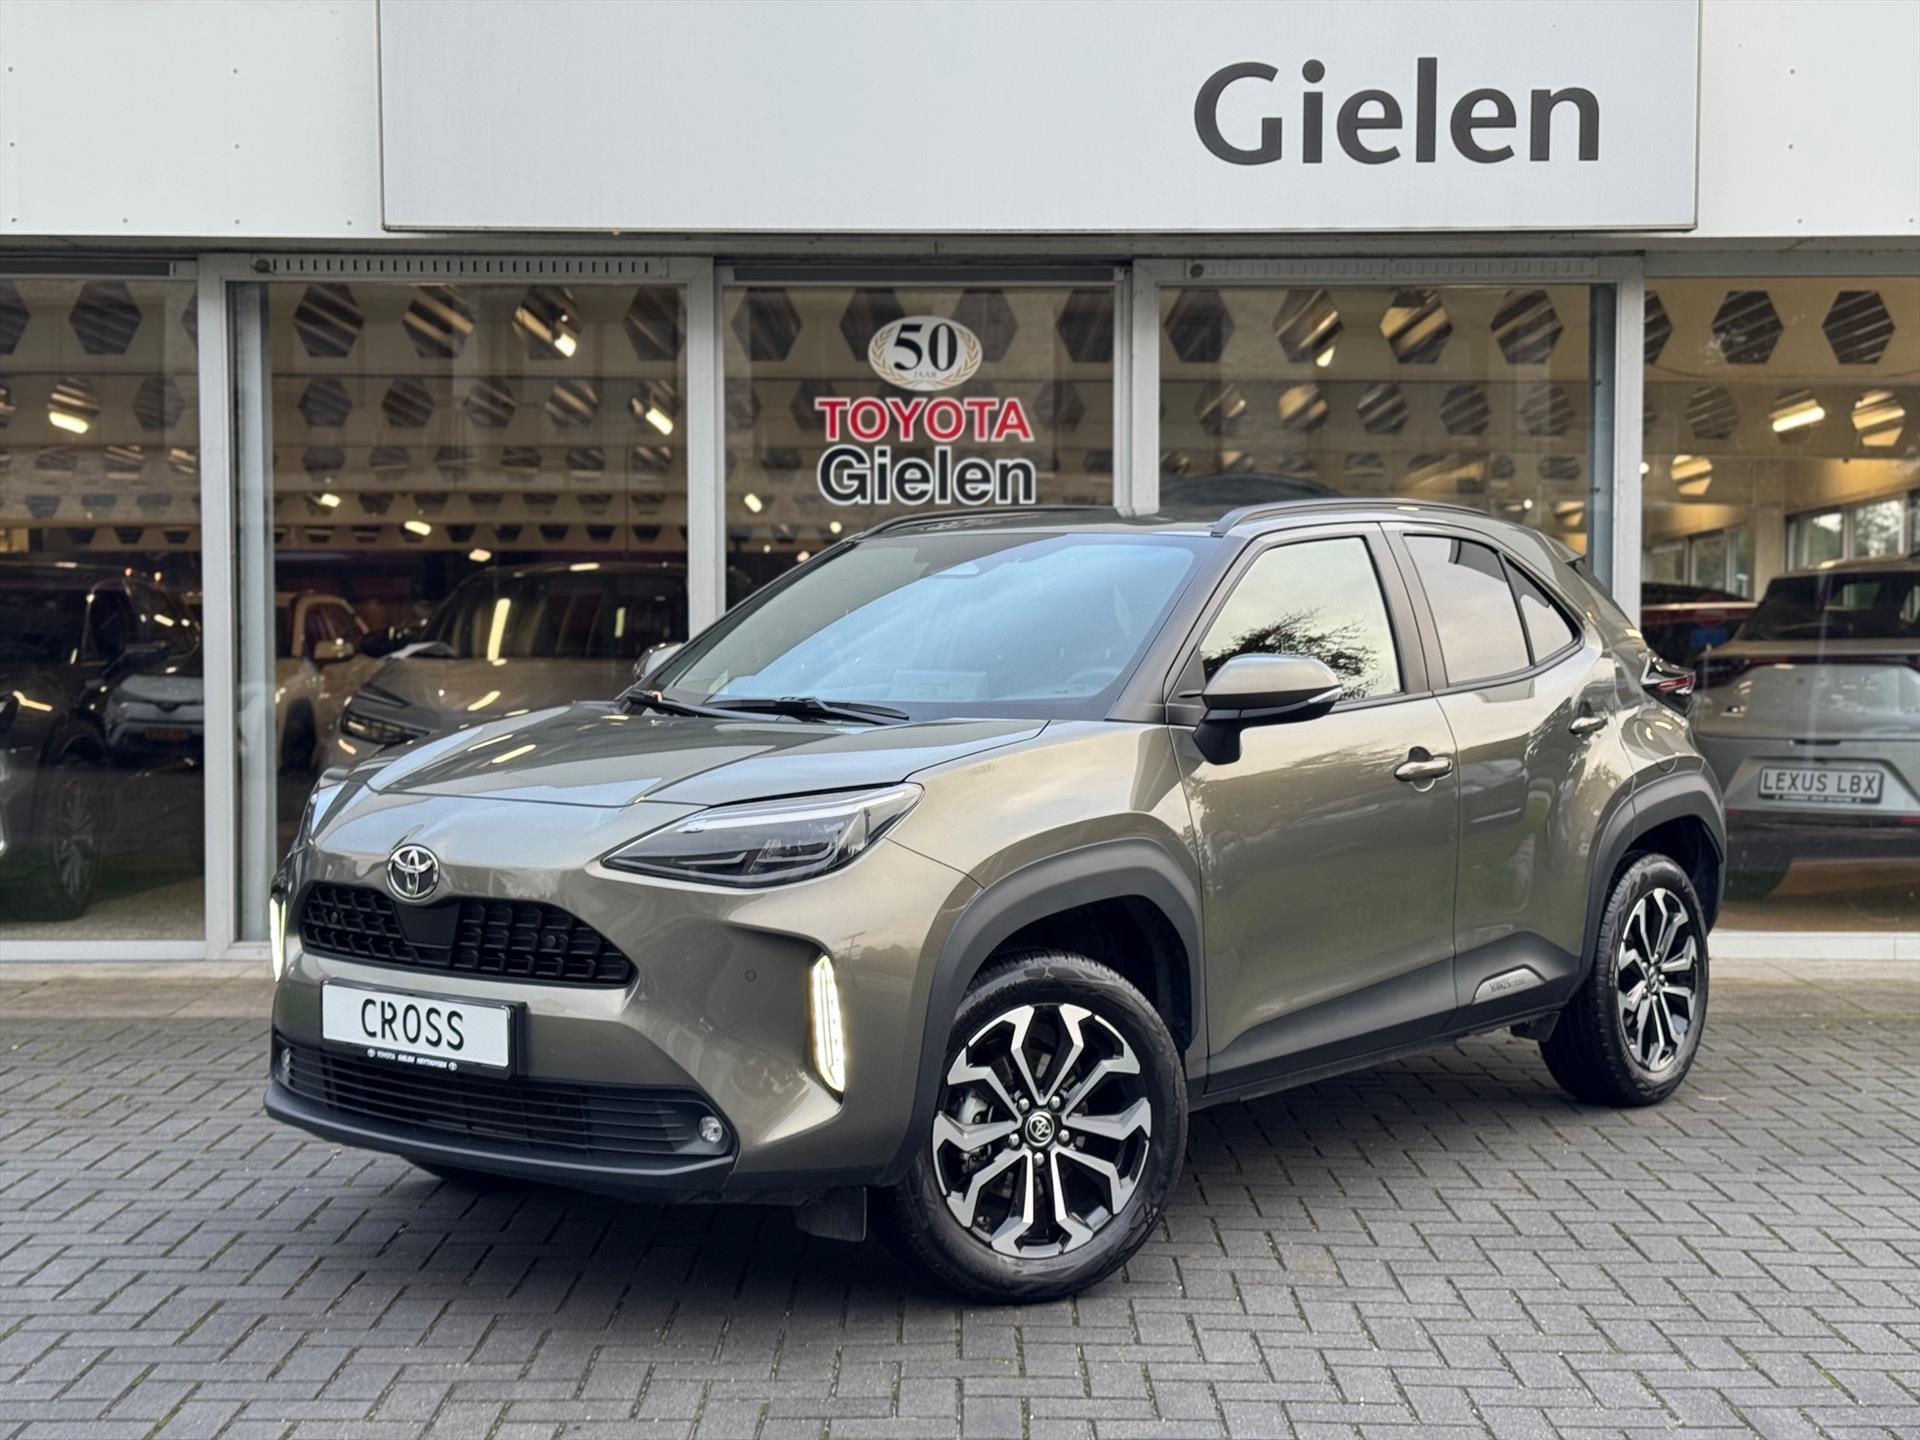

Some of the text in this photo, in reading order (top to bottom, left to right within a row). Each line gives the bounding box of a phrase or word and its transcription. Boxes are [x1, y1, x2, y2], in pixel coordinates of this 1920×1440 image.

[1194, 57, 1600, 166] Gielen
[893, 323, 958, 371] 50
[815, 398, 1034, 441] TOYOTA
[817, 445, 1036, 505] Gielen
[1763, 772, 1876, 794] LEXUS LBX
[361, 998, 465, 1051] CROSS
